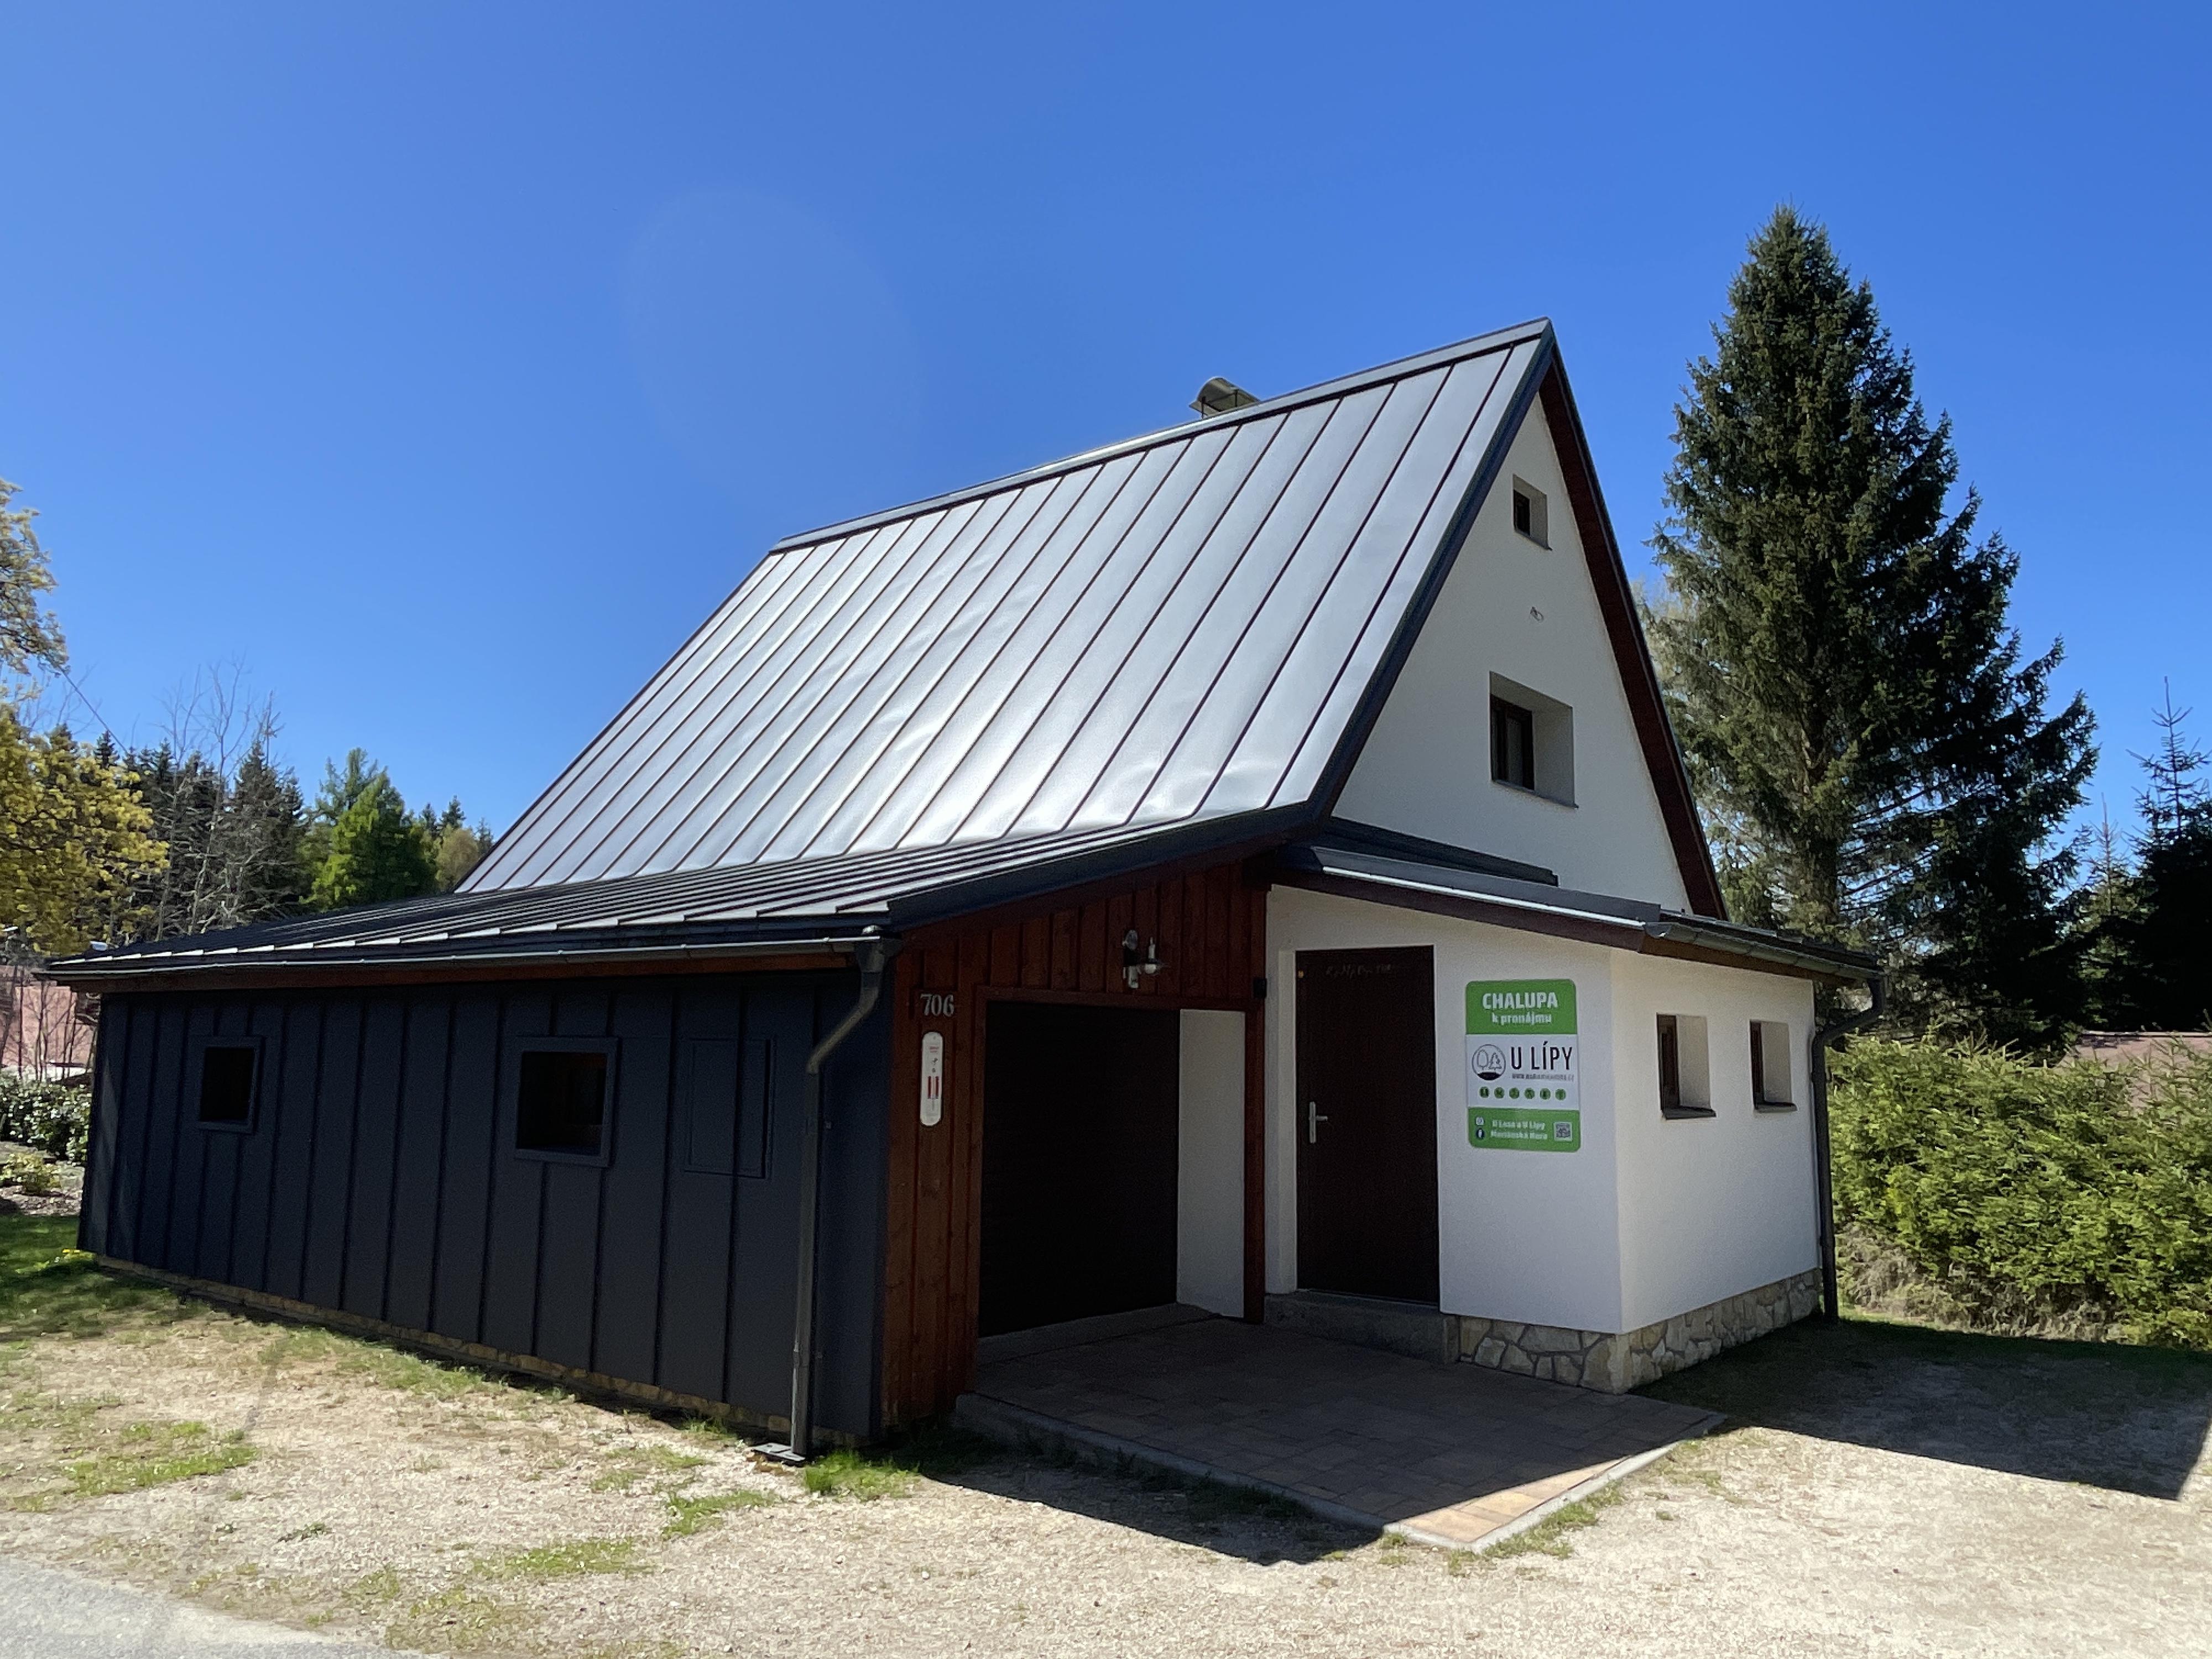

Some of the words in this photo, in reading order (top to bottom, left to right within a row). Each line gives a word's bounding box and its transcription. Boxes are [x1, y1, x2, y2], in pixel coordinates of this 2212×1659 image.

[920, 994, 954, 1017] 706
[1483, 992, 1558, 1009] CHALUPA
[1491, 1012, 1499, 1022] k
[1501, 1011, 1552, 1025] pronájmu
[1511, 1046, 1522, 1070] U
[1531, 1040, 1573, 1070] LÍPY
